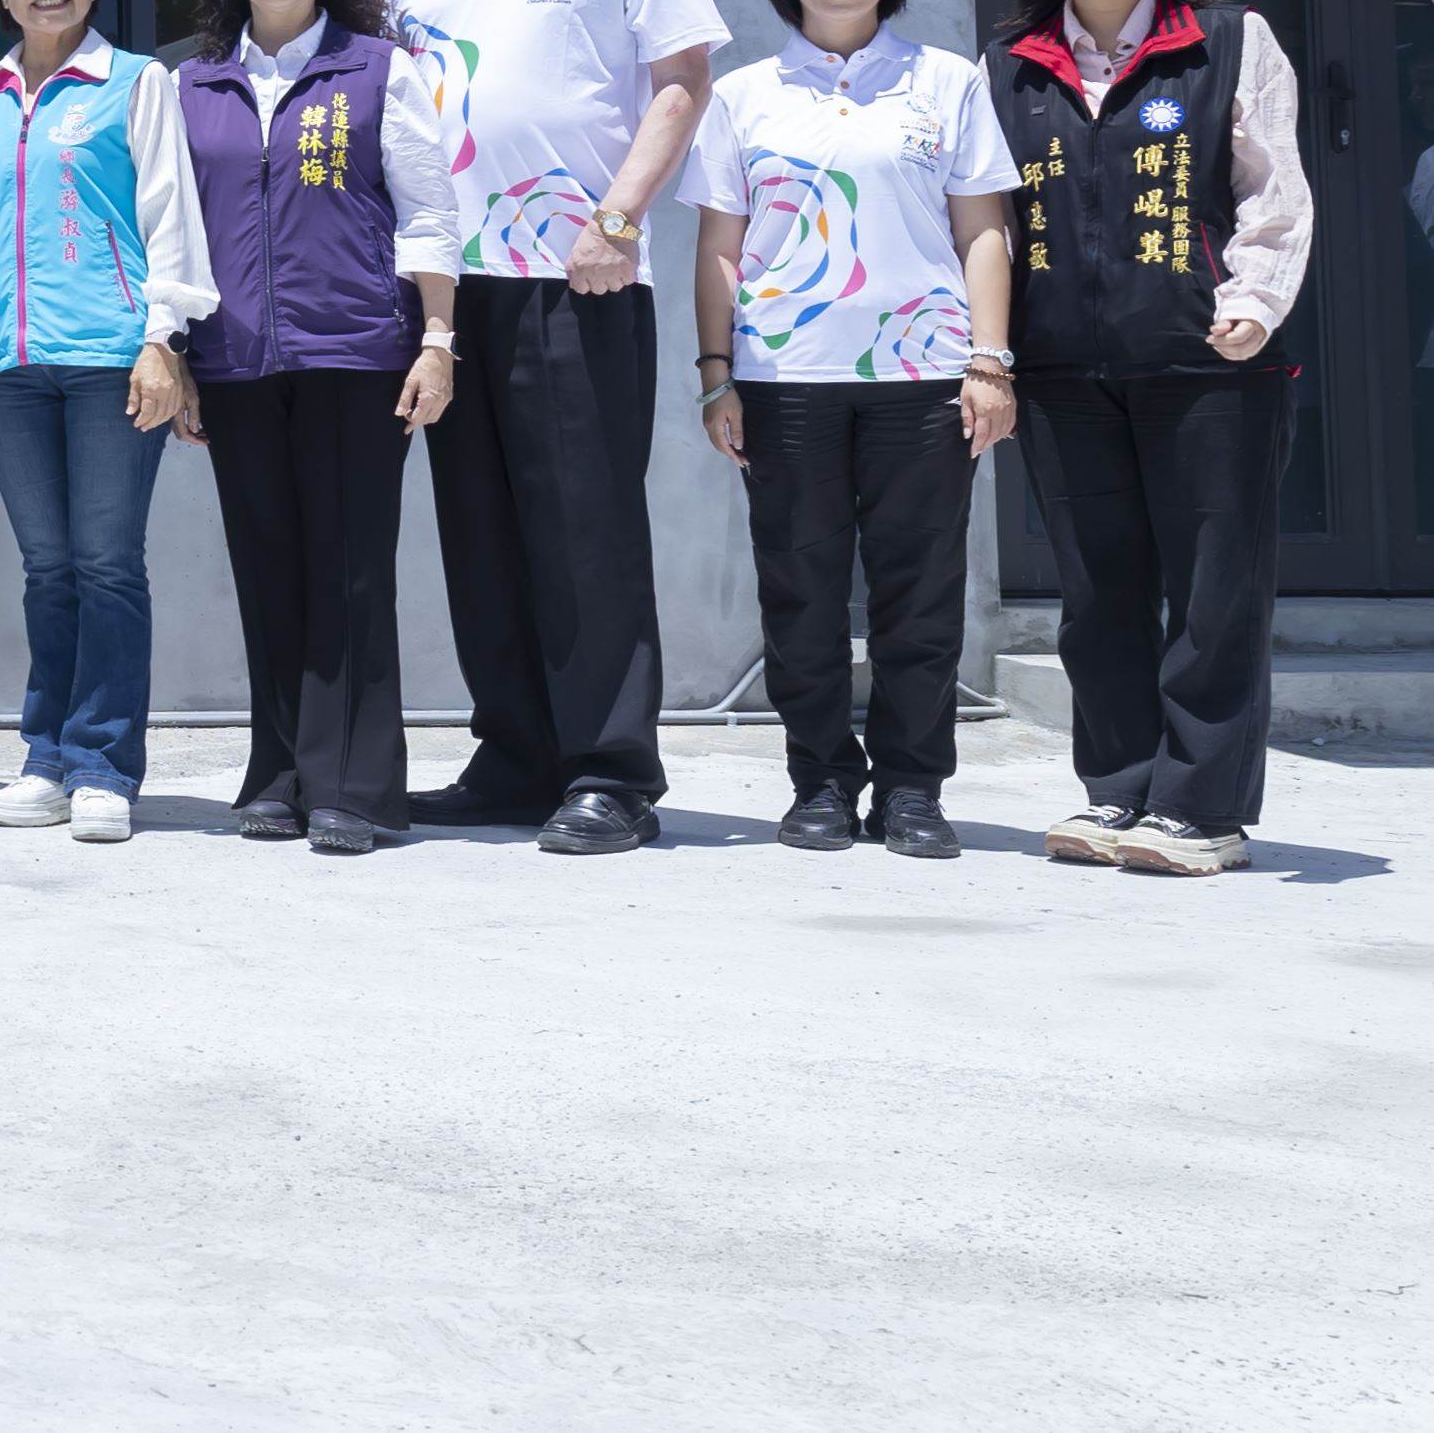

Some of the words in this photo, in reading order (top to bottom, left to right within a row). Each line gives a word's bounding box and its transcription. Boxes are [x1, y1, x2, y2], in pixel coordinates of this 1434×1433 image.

[297, 104, 328, 186] 韓林梅
[330, 92, 350, 191] 花蓮縣議員
[1047, 136, 1065, 177] 主任
[1172, 133, 1192, 199] 立法委員
[1171, 205, 1194, 274] 服務團隊
